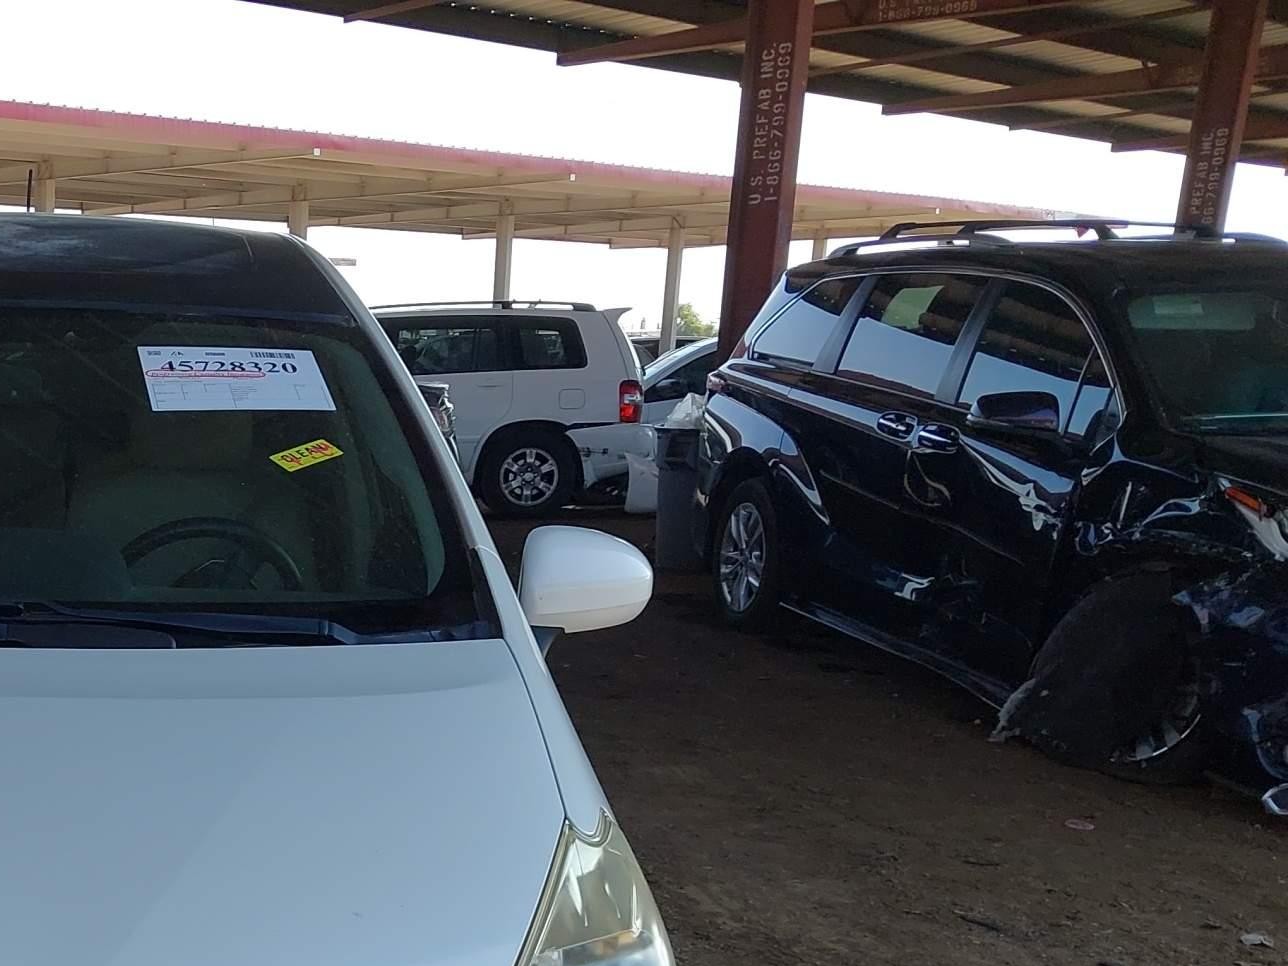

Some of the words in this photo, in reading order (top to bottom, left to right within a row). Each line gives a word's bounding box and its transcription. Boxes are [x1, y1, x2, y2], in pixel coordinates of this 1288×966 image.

[760, 42, 778, 80] INC.
[752, 88, 773, 160] PREFAB
[764, 41, 793, 202] 1-866-799-0969
[747, 169, 764, 206] U.S.
[1190, 160, 1209, 215] PREFAB
[161, 360, 298, 374] 45728320
